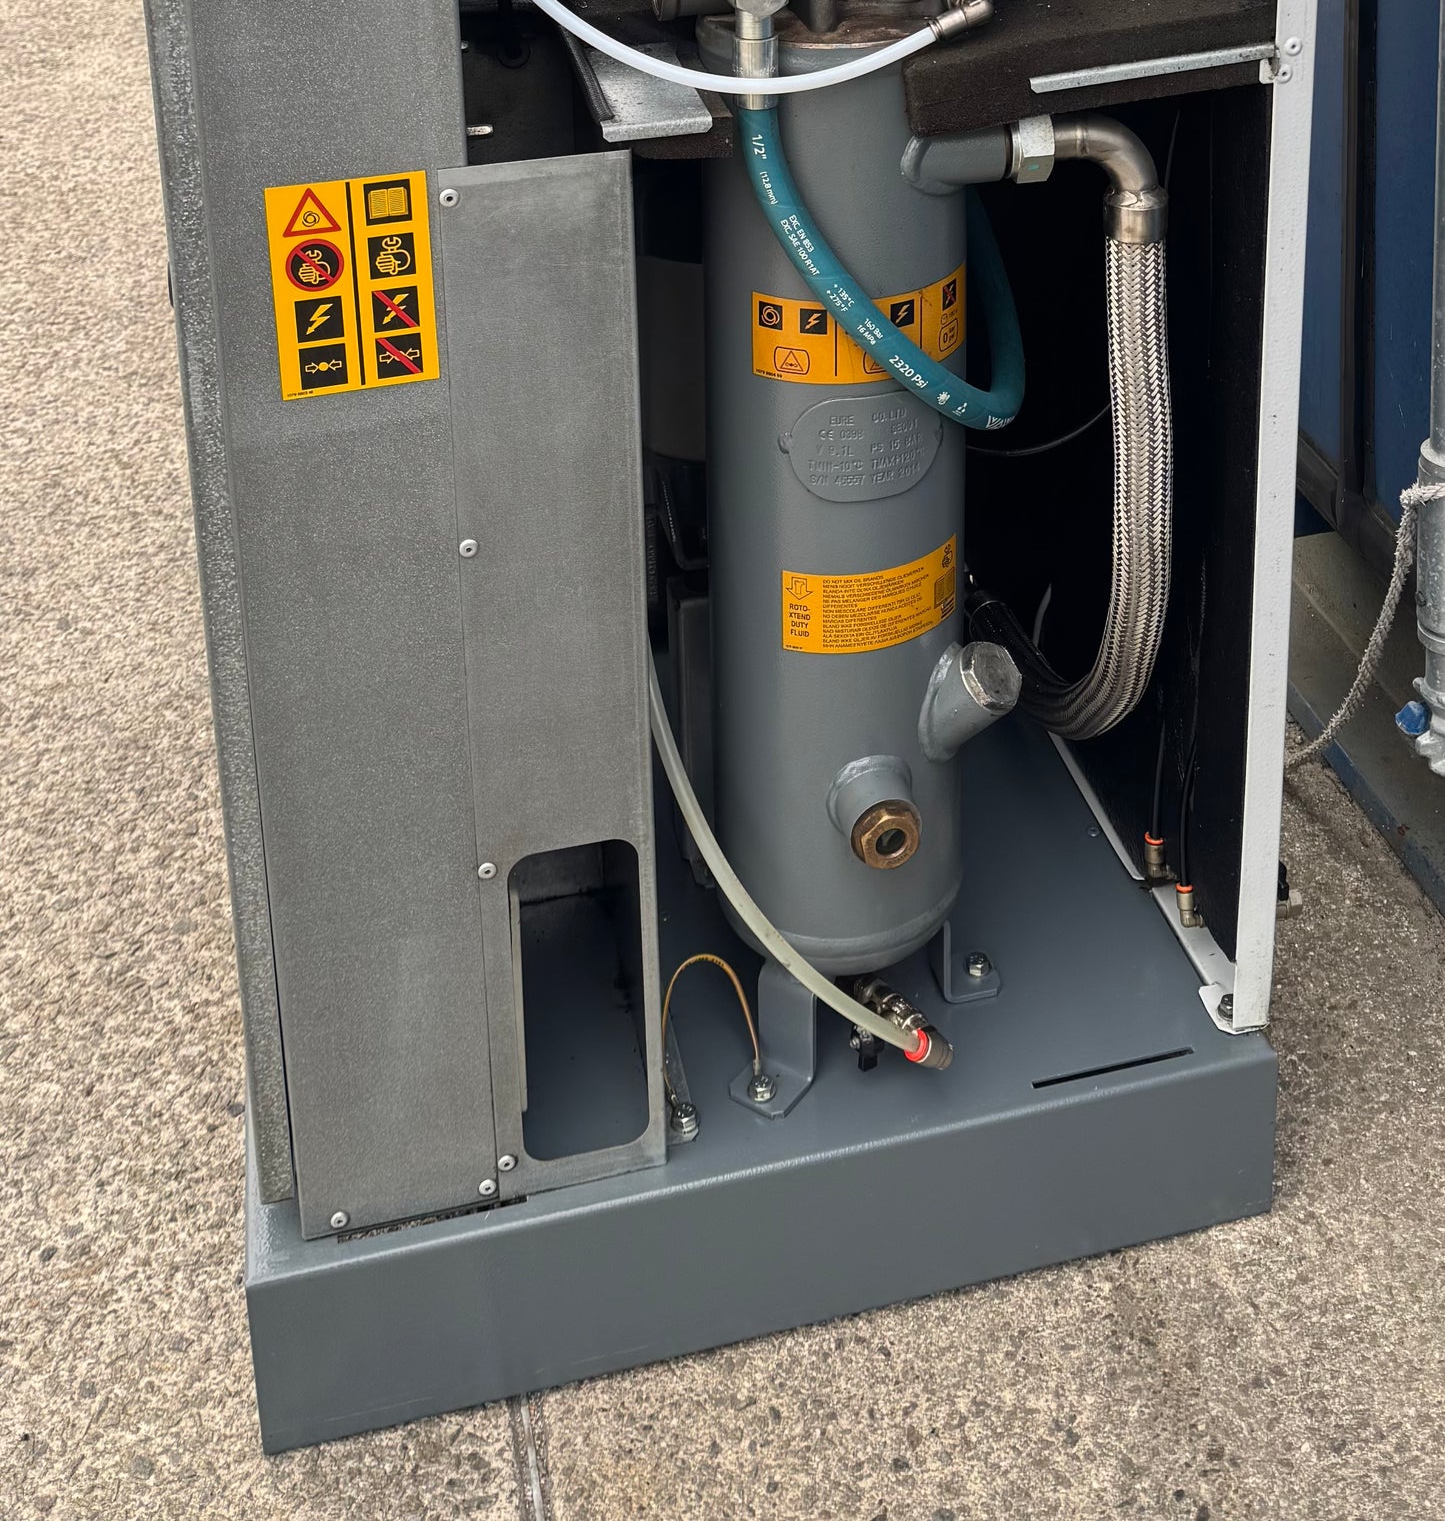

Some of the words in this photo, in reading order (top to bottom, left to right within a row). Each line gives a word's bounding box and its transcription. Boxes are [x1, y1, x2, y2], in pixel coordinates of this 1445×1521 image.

[752, 134, 767, 160] 1/2"
[797, 228, 806, 240] EN
[802, 238, 815, 253] 853
[788, 233, 801, 248] SAE
[797, 246, 809, 260] 100
[804, 258, 821, 276] R1AT
[856, 324, 865, 335] 16
[861, 330, 877, 346] MPa
[864, 317, 876, 332] 160
[872, 328, 884, 340] Bar
[889, 354, 916, 379] 2320
[911, 374, 929, 389] Psi
[789, 612, 811, 620] XTEND
[790, 603, 811, 612] ROTO-
[790, 628, 810, 637] FLUID
[791, 620, 808, 628] DUTY
